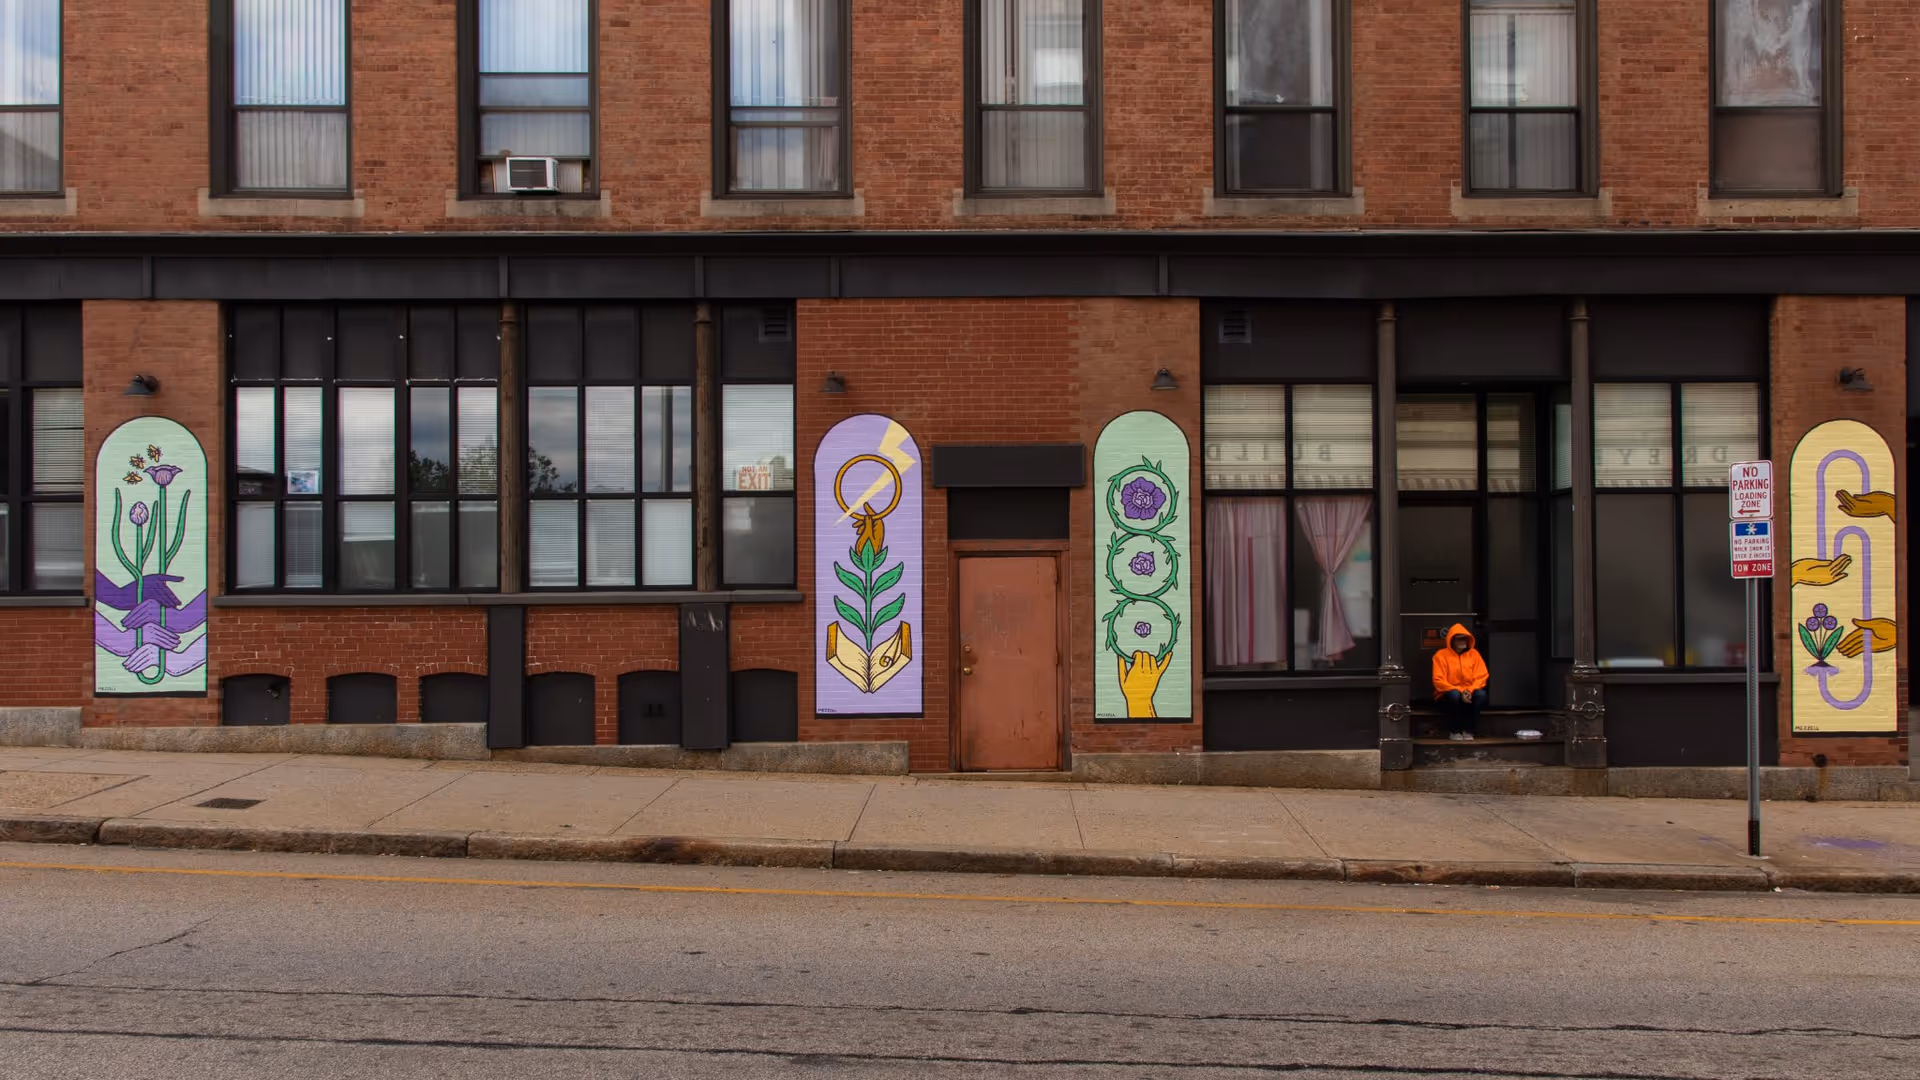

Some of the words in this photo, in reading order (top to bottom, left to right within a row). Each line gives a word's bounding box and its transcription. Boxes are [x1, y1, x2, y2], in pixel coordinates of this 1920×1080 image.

[1742, 466, 1759, 478] NO
[738, 473, 769, 489] EXIT
[1732, 478, 1769, 490] PARKING
[1734, 491, 1767, 500] LOADING
[1741, 500, 1761, 508] ZONE
[1733, 563, 1749, 572] TOW
[1752, 562, 1772, 572] ZONE
